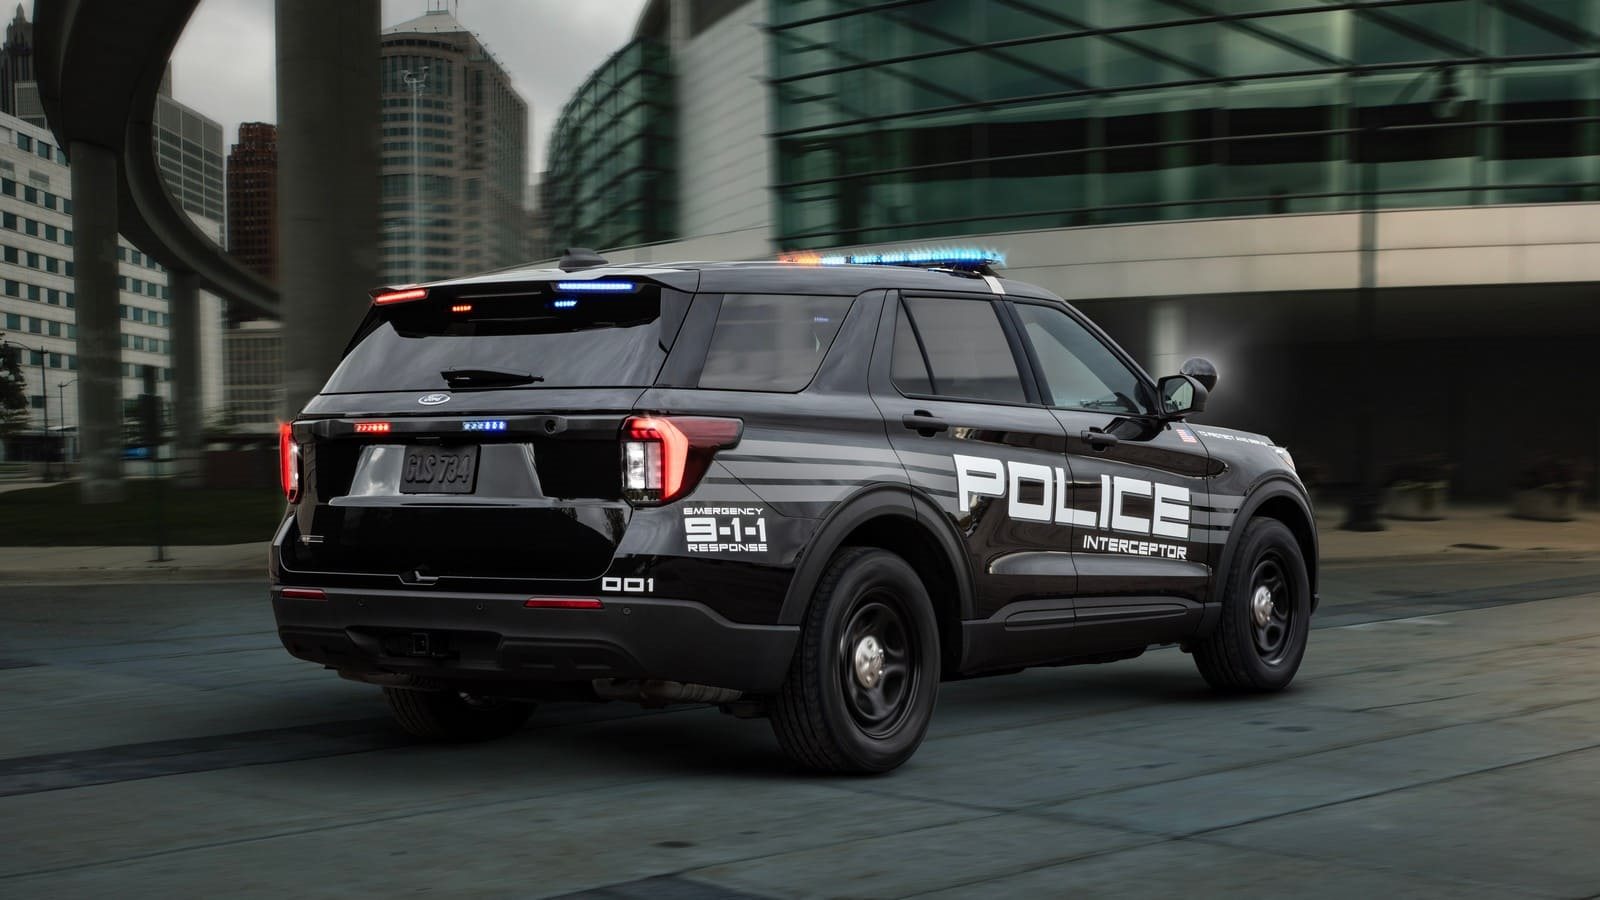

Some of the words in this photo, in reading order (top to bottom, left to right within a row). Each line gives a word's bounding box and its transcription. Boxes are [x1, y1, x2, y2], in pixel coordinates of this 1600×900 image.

[438, 454, 470, 483] 734
[953, 454, 1190, 539] POLICE
[683, 507, 764, 515] EMERGENCY
[684, 517, 767, 542] 9-1-1
[687, 543, 768, 552] RESPONSE
[1083, 534, 1188, 560] INTERCEPTOR
[601, 577, 654, 592] 001
